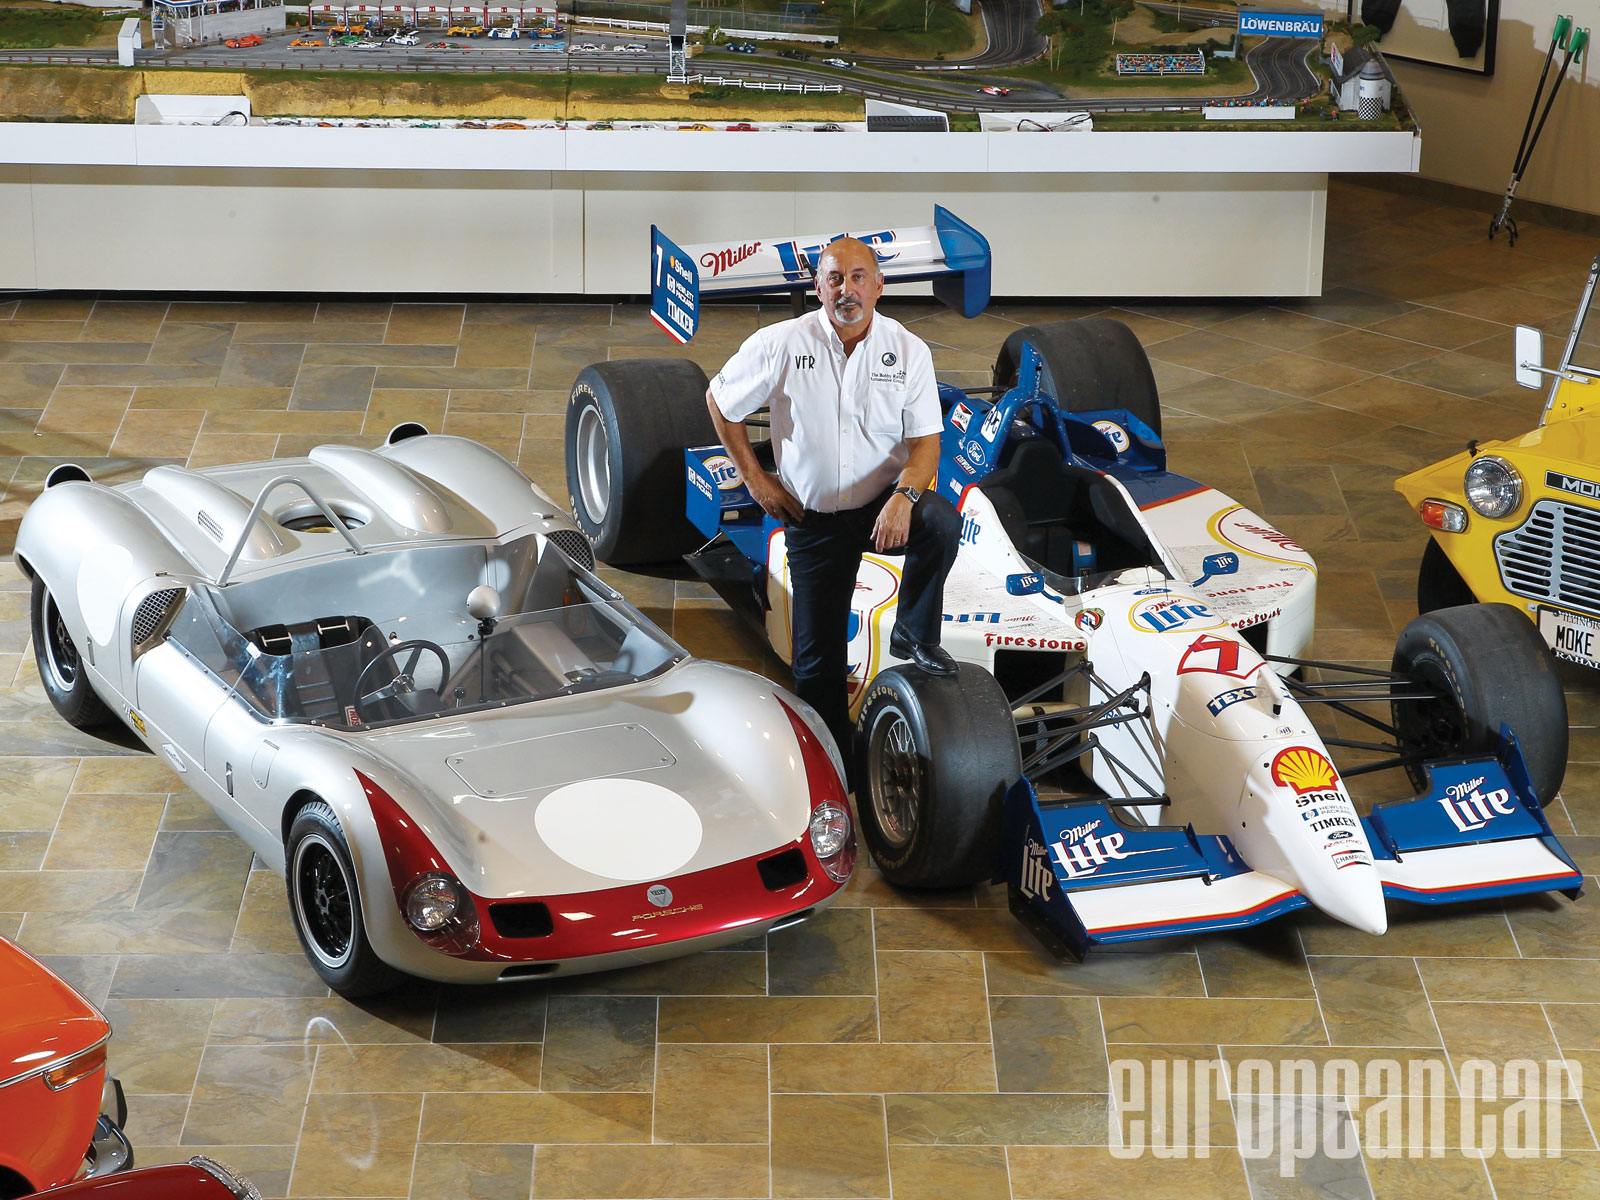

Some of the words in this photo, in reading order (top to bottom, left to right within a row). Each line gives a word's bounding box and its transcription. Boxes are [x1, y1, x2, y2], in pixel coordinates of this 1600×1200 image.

[1241, 17, 1320, 33] LÖWENBRÄU
[700, 241, 761, 276] Miller
[674, 259, 693, 285] Shell
[667, 297, 694, 336] TIMKEN
[968, 442, 982, 462] Ford
[1139, 604, 1214, 633] Lite
[984, 633, 1086, 651] Firestone
[1555, 624, 1595, 657] MOKE
[1296, 792, 1346, 807] Shell
[1446, 776, 1486, 801] Miller
[1437, 788, 1517, 832] Lite
[1059, 820, 1101, 845] Miller
[1310, 817, 1357, 832] TIMKEN
[1028, 838, 1048, 856] Miller
[1049, 832, 1128, 879] Lite
[1020, 845, 1053, 902] Lite
